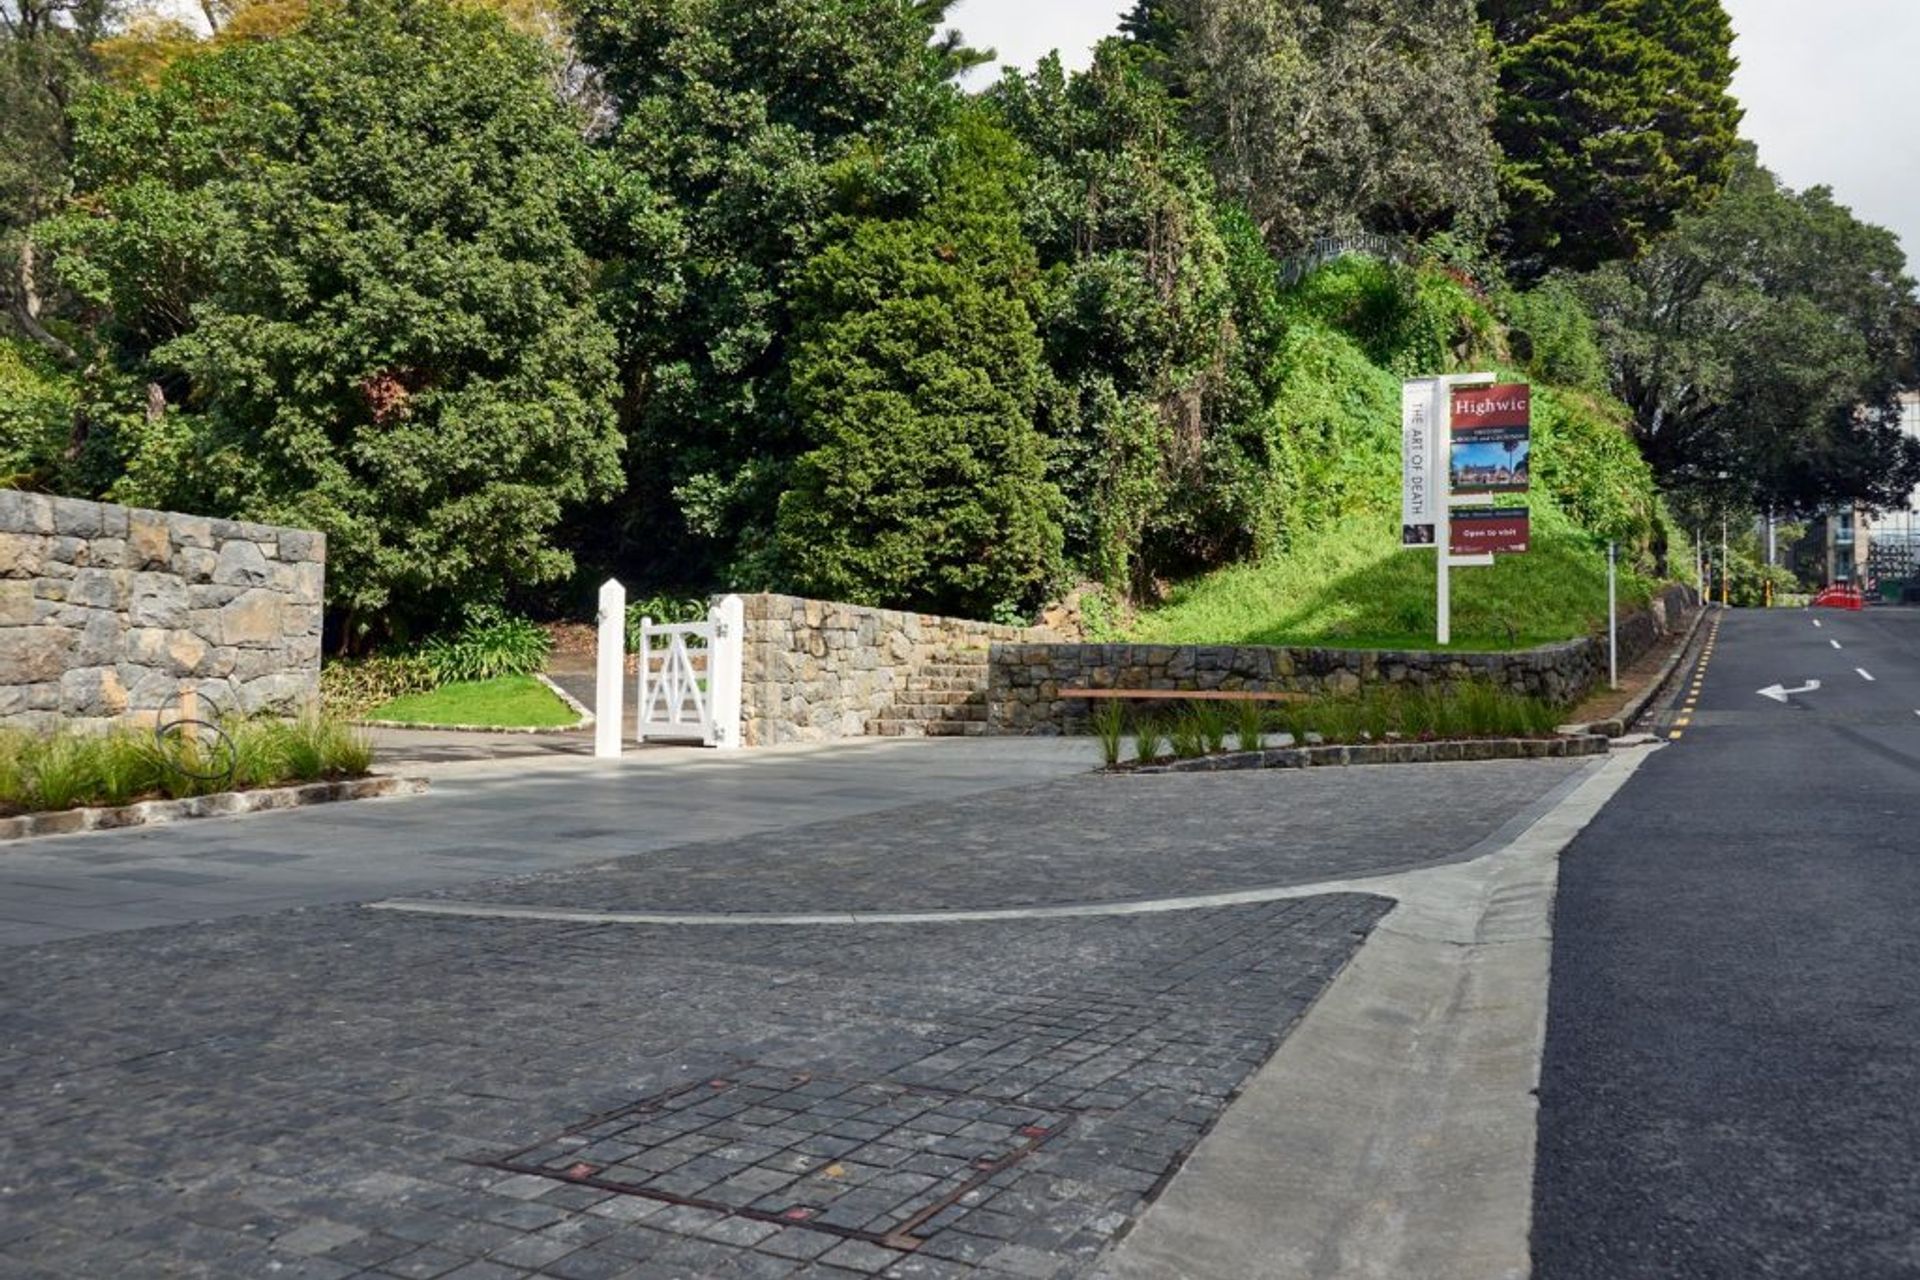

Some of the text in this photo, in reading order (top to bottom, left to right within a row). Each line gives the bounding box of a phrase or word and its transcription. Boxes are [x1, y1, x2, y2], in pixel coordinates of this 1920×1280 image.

[1455, 397, 1526, 417] Highwic
[1411, 403, 1422, 514] THE ART OF DEATH
[1463, 529, 1486, 538] Open
[1497, 528, 1516, 537] visit
